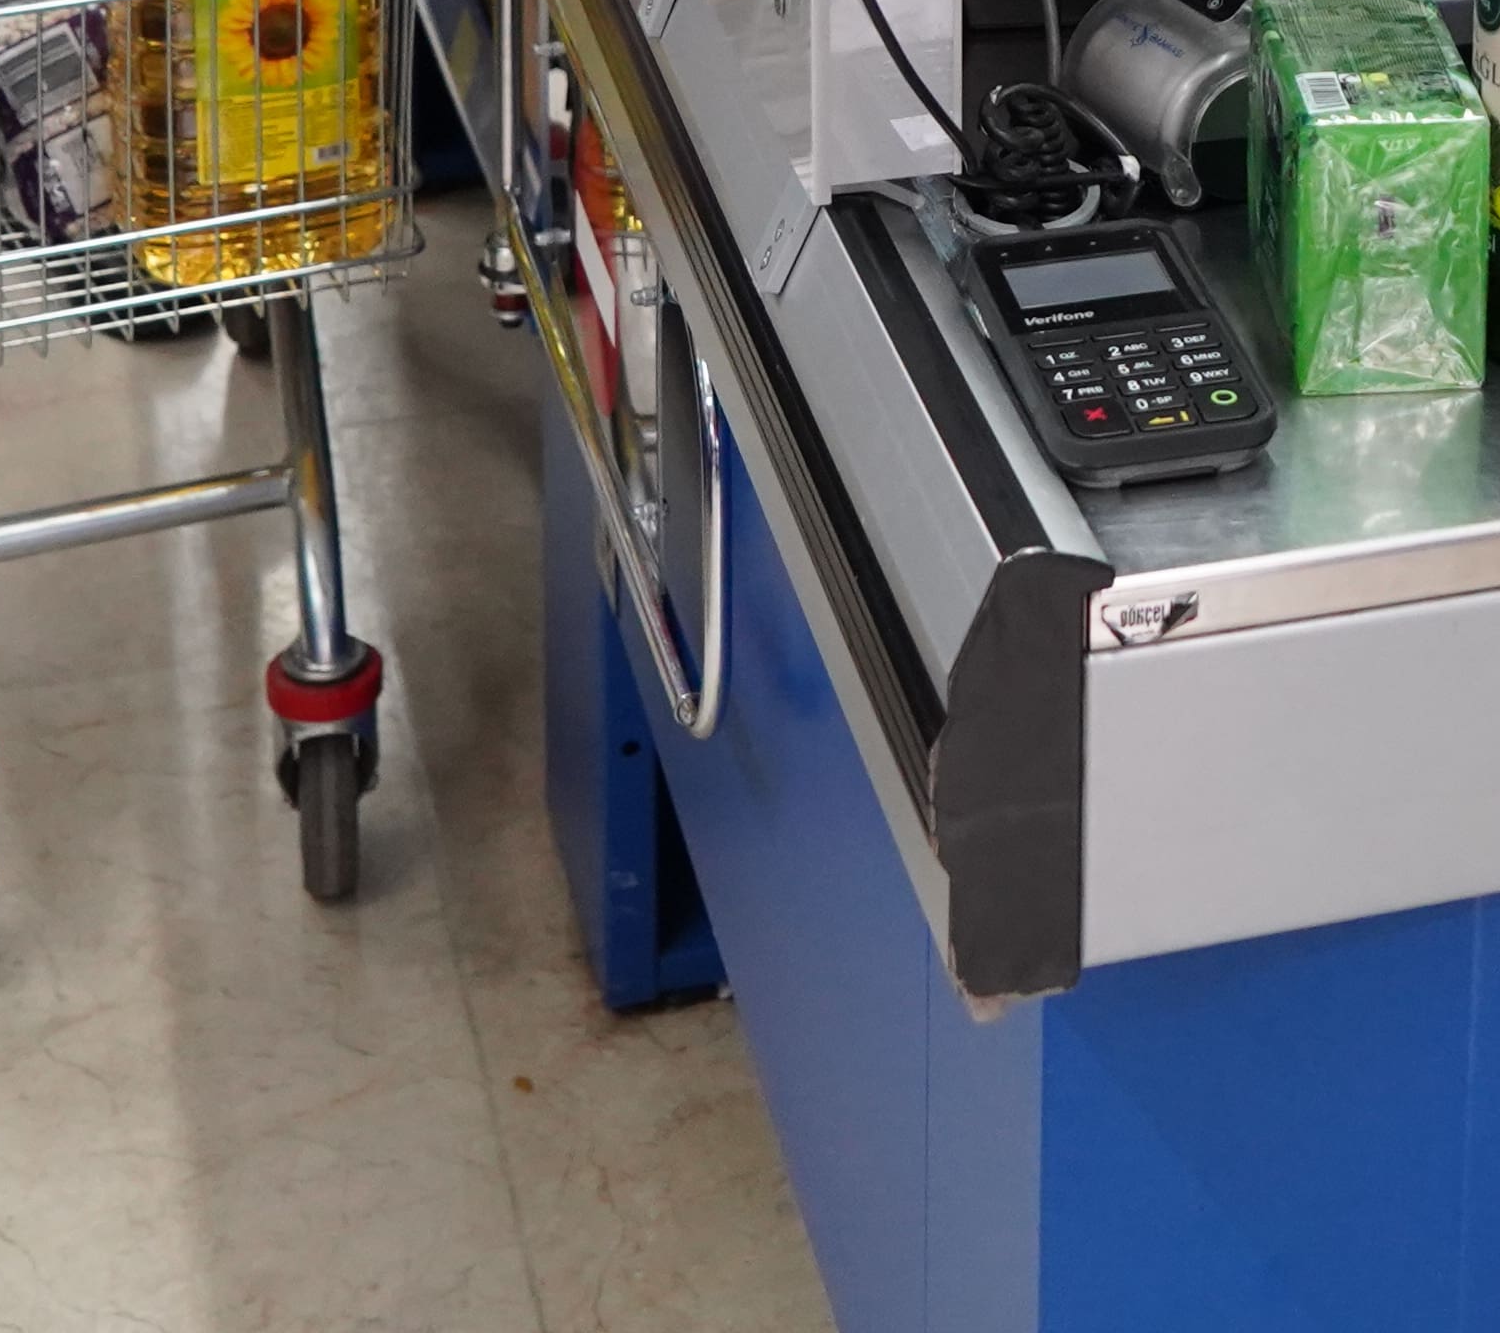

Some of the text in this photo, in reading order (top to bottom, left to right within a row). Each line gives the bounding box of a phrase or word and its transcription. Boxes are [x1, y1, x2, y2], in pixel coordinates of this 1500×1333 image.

[1025, 309, 1094, 327] Verifone
[1171, 337, 1184, 348] 3
[1108, 342, 1148, 357] 2 ABC
[1046, 355, 1055, 365] 1
[1180, 354, 1193, 365] 6
[1117, 364, 1130, 374] 5
[1190, 368, 1229, 382] 9 WXY
[1054, 371, 1065, 382] 4
[1127, 377, 1166, 391] 8 TUV
[1062, 388, 1073, 400] 7
[1136, 398, 1148, 410] 0
